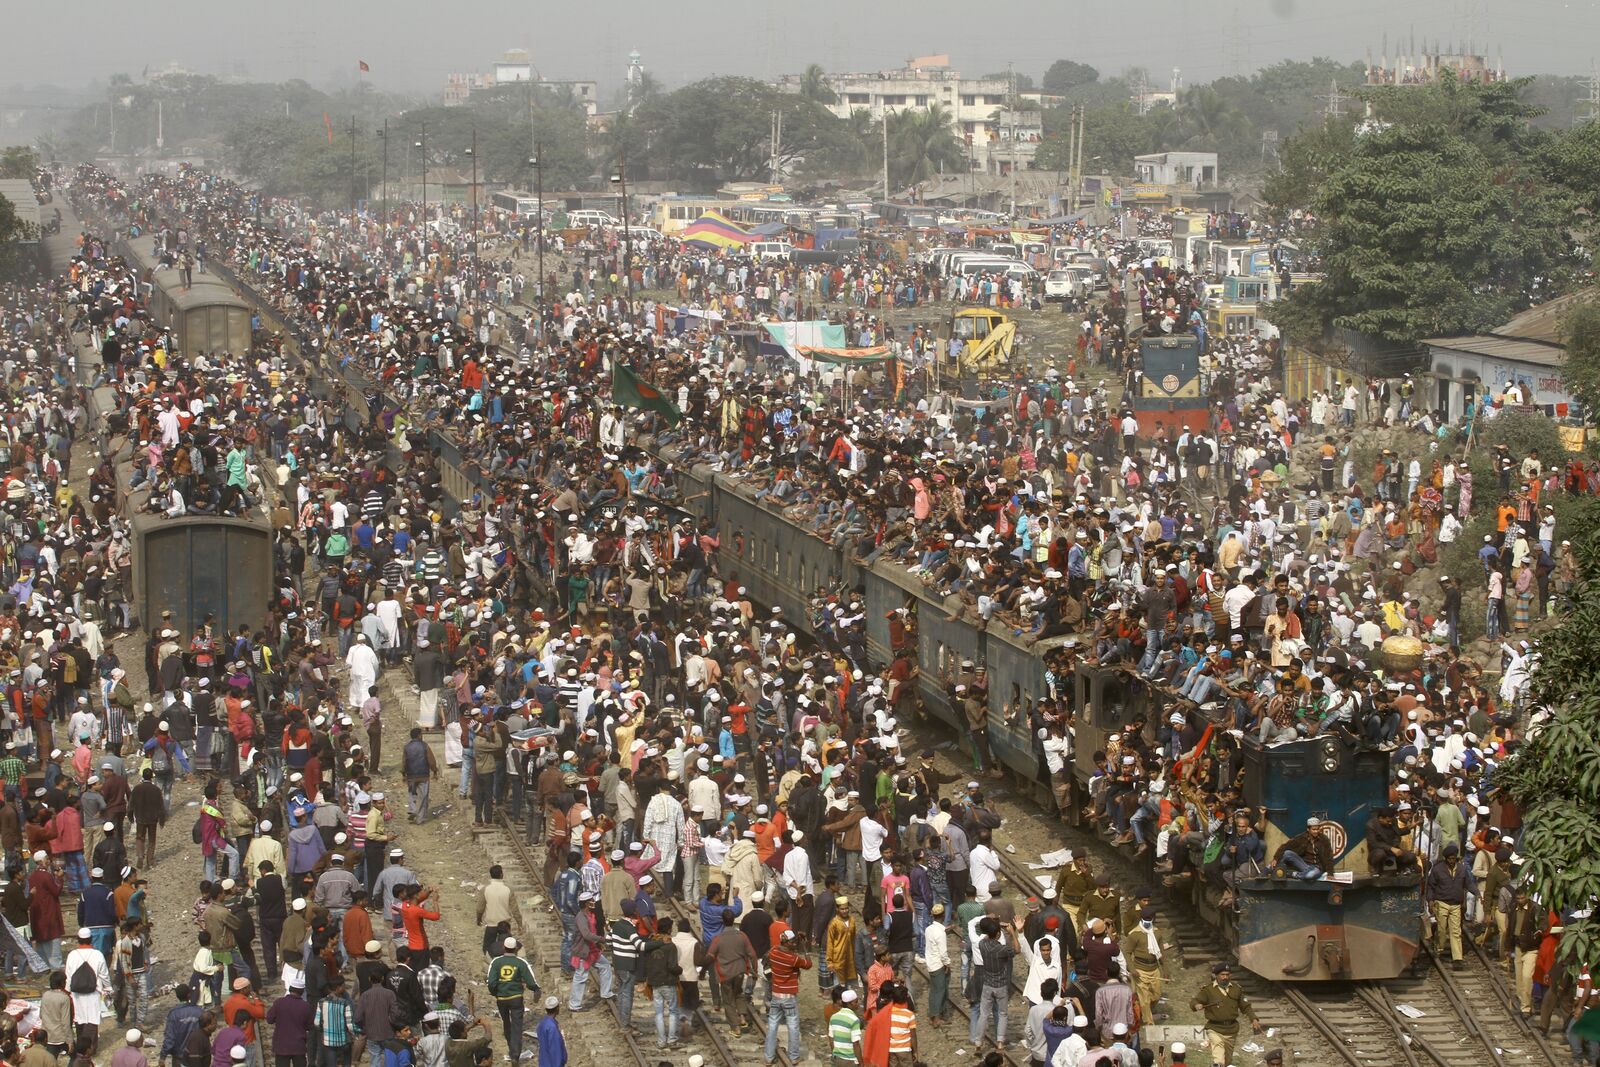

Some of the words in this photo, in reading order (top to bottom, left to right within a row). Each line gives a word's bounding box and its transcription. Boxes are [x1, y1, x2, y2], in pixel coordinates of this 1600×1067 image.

[503, 968, 513, 976] D
[1163, 1027, 1170, 1041] F
[1193, 1027, 1206, 1040] M
